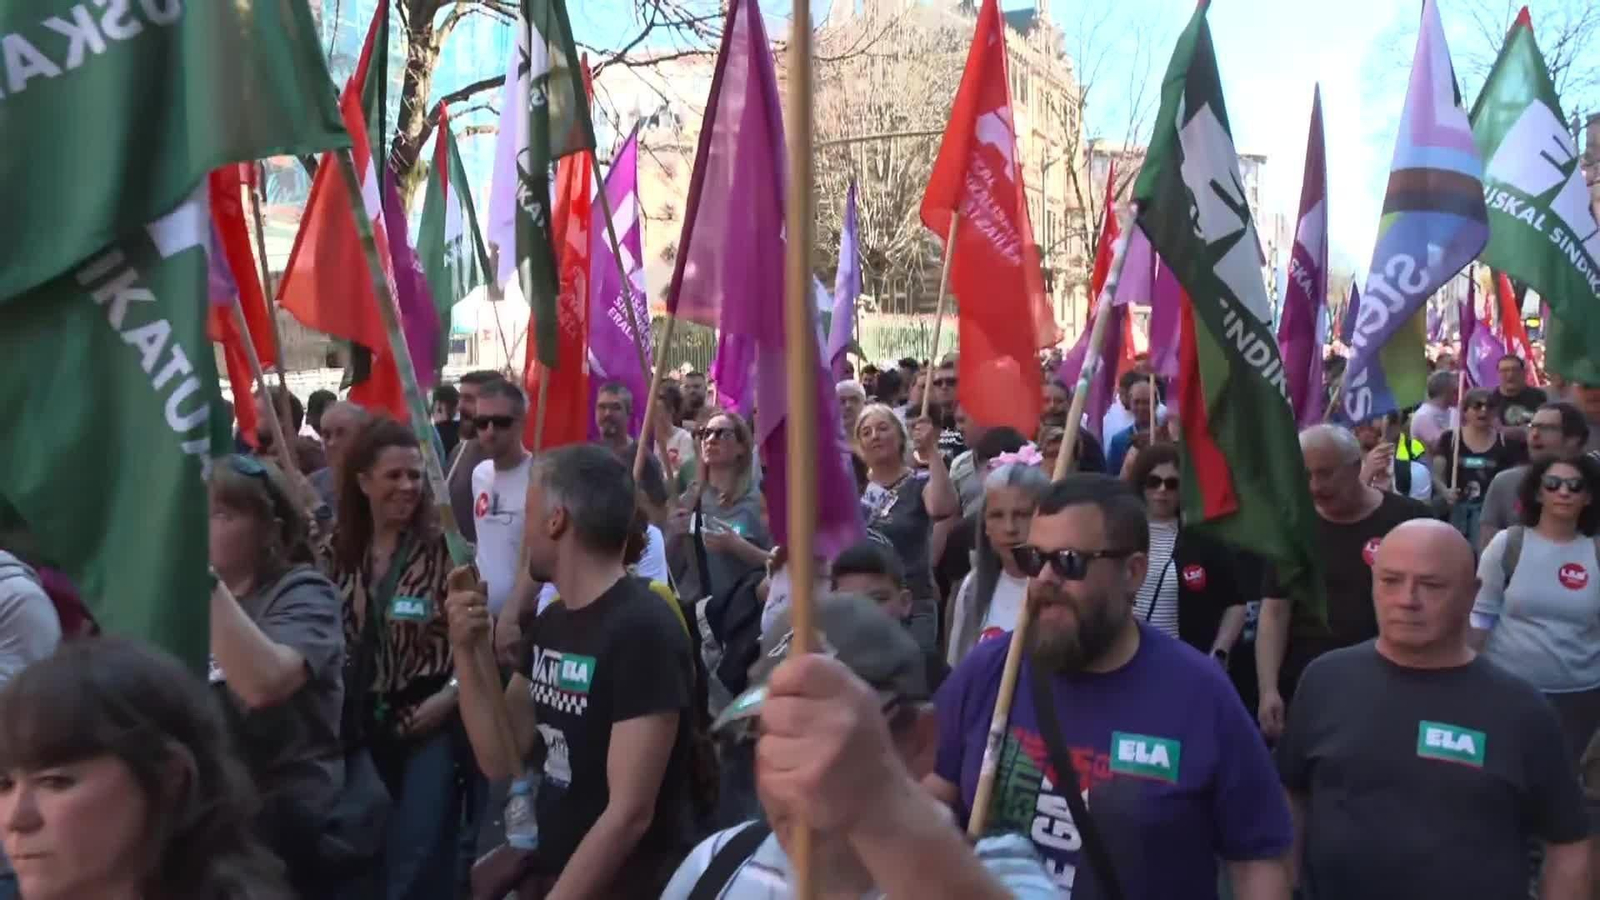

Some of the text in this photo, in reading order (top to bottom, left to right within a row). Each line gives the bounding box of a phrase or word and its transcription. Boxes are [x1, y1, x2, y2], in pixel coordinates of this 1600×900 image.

[562, 659, 588, 684] ELA
[1118, 739, 1171, 770] ELA
[1425, 727, 1476, 755] ELA
